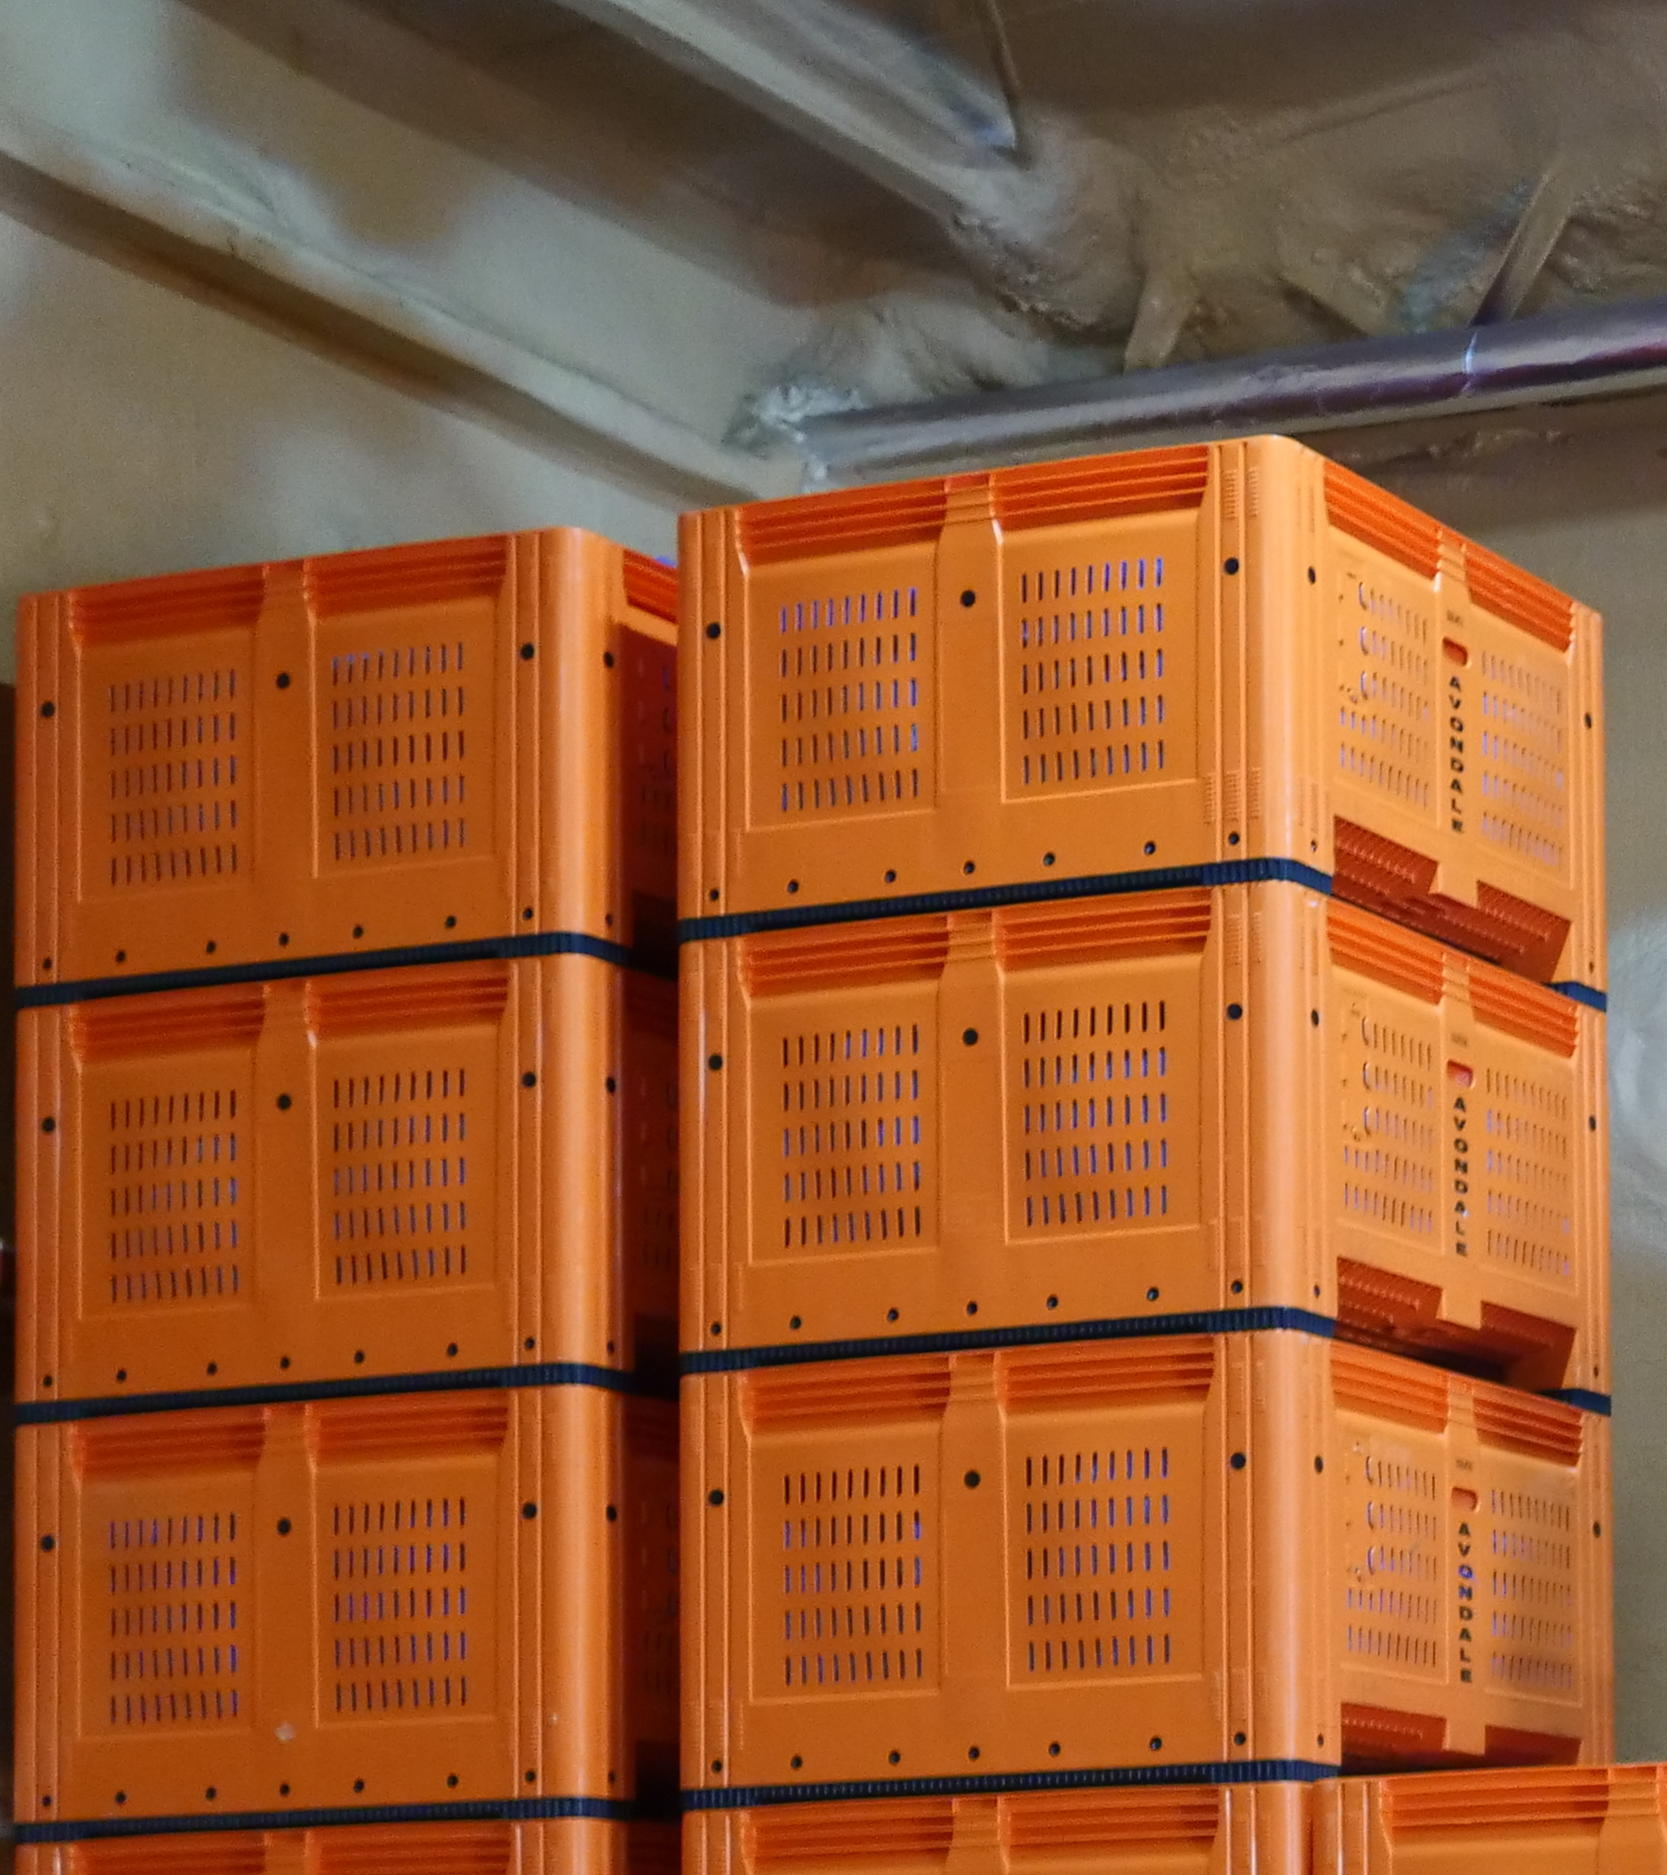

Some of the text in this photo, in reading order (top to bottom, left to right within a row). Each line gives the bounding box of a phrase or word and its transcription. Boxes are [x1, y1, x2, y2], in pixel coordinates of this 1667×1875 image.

[1449, 675, 1465, 834] AVONDALE
[1453, 1096, 1469, 1257] AVONDALE
[1457, 1522, 1473, 1683] AVONDALE
